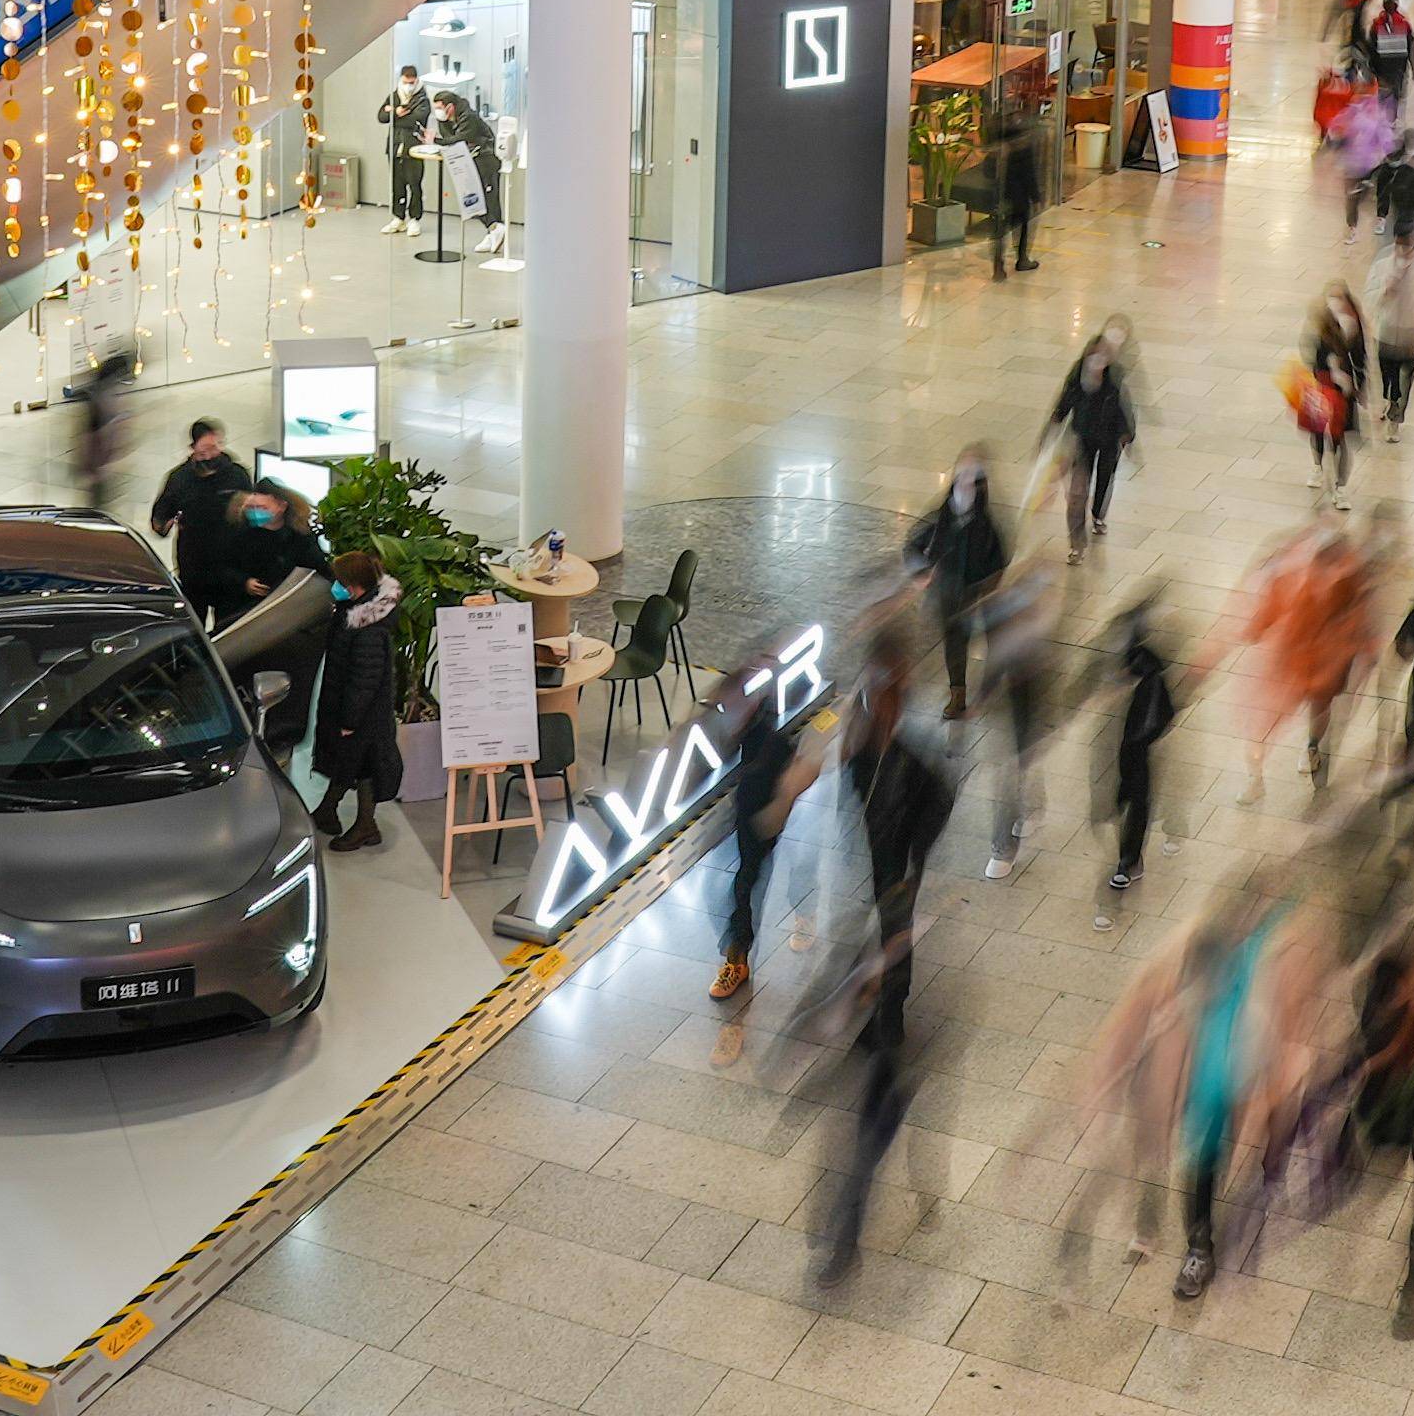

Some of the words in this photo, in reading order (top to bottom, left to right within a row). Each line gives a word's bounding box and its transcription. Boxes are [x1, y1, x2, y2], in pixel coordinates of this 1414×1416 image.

[536, 620, 825, 928] AVAR
[98, 980, 159, 1001] 阿维塔
